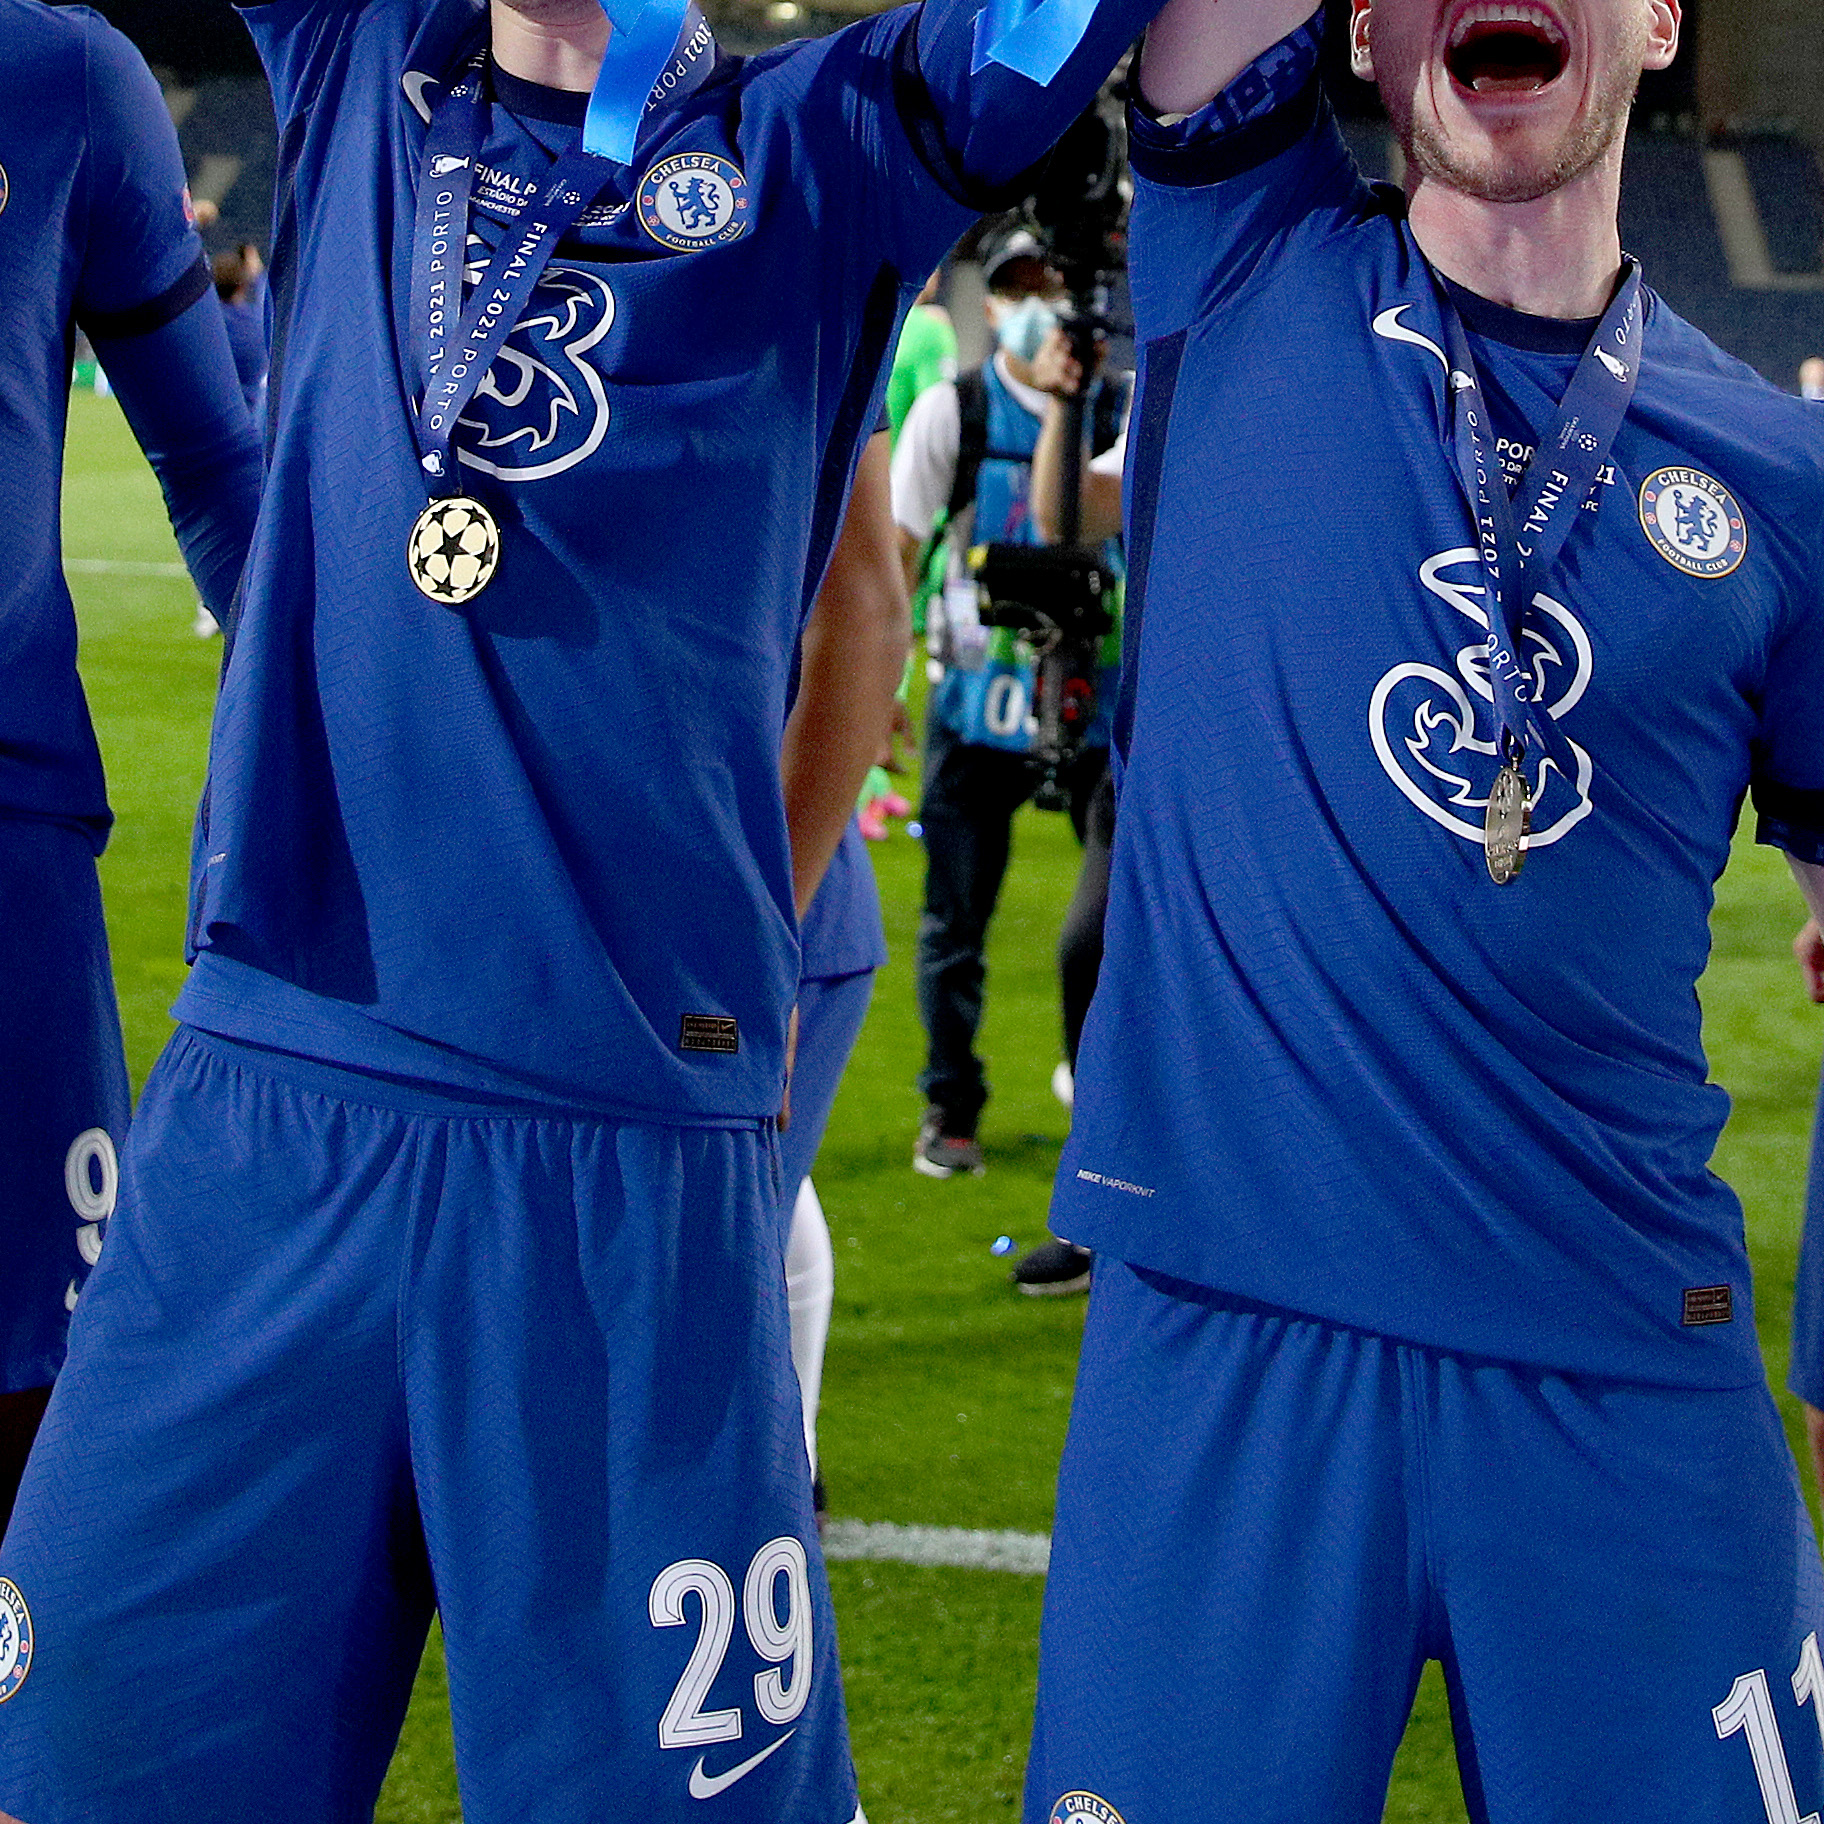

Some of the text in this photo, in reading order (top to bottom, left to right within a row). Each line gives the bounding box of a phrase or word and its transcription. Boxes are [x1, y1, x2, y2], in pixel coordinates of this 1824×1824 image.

[473, 162, 522, 194] FINAL
[650, 156, 721, 185] CHELSEA
[430, 190, 453, 273] PORTO
[665, 220, 740, 248] FOOTBALL CLUB
[428, 280, 446, 339] 2021
[429, 222, 548, 431] FINAL 2021 PORTO
[1522, 469, 1569, 534] FINAL
[1657, 470, 1728, 505] CHELSEA
[1657, 537, 1729, 572] FOOTBALL CLUB
[64, 1126, 120, 1266] 9
[1076, 1168, 1156, 1198] NIKE VAPORKNIT
[647, 1535, 814, 1749] 29
